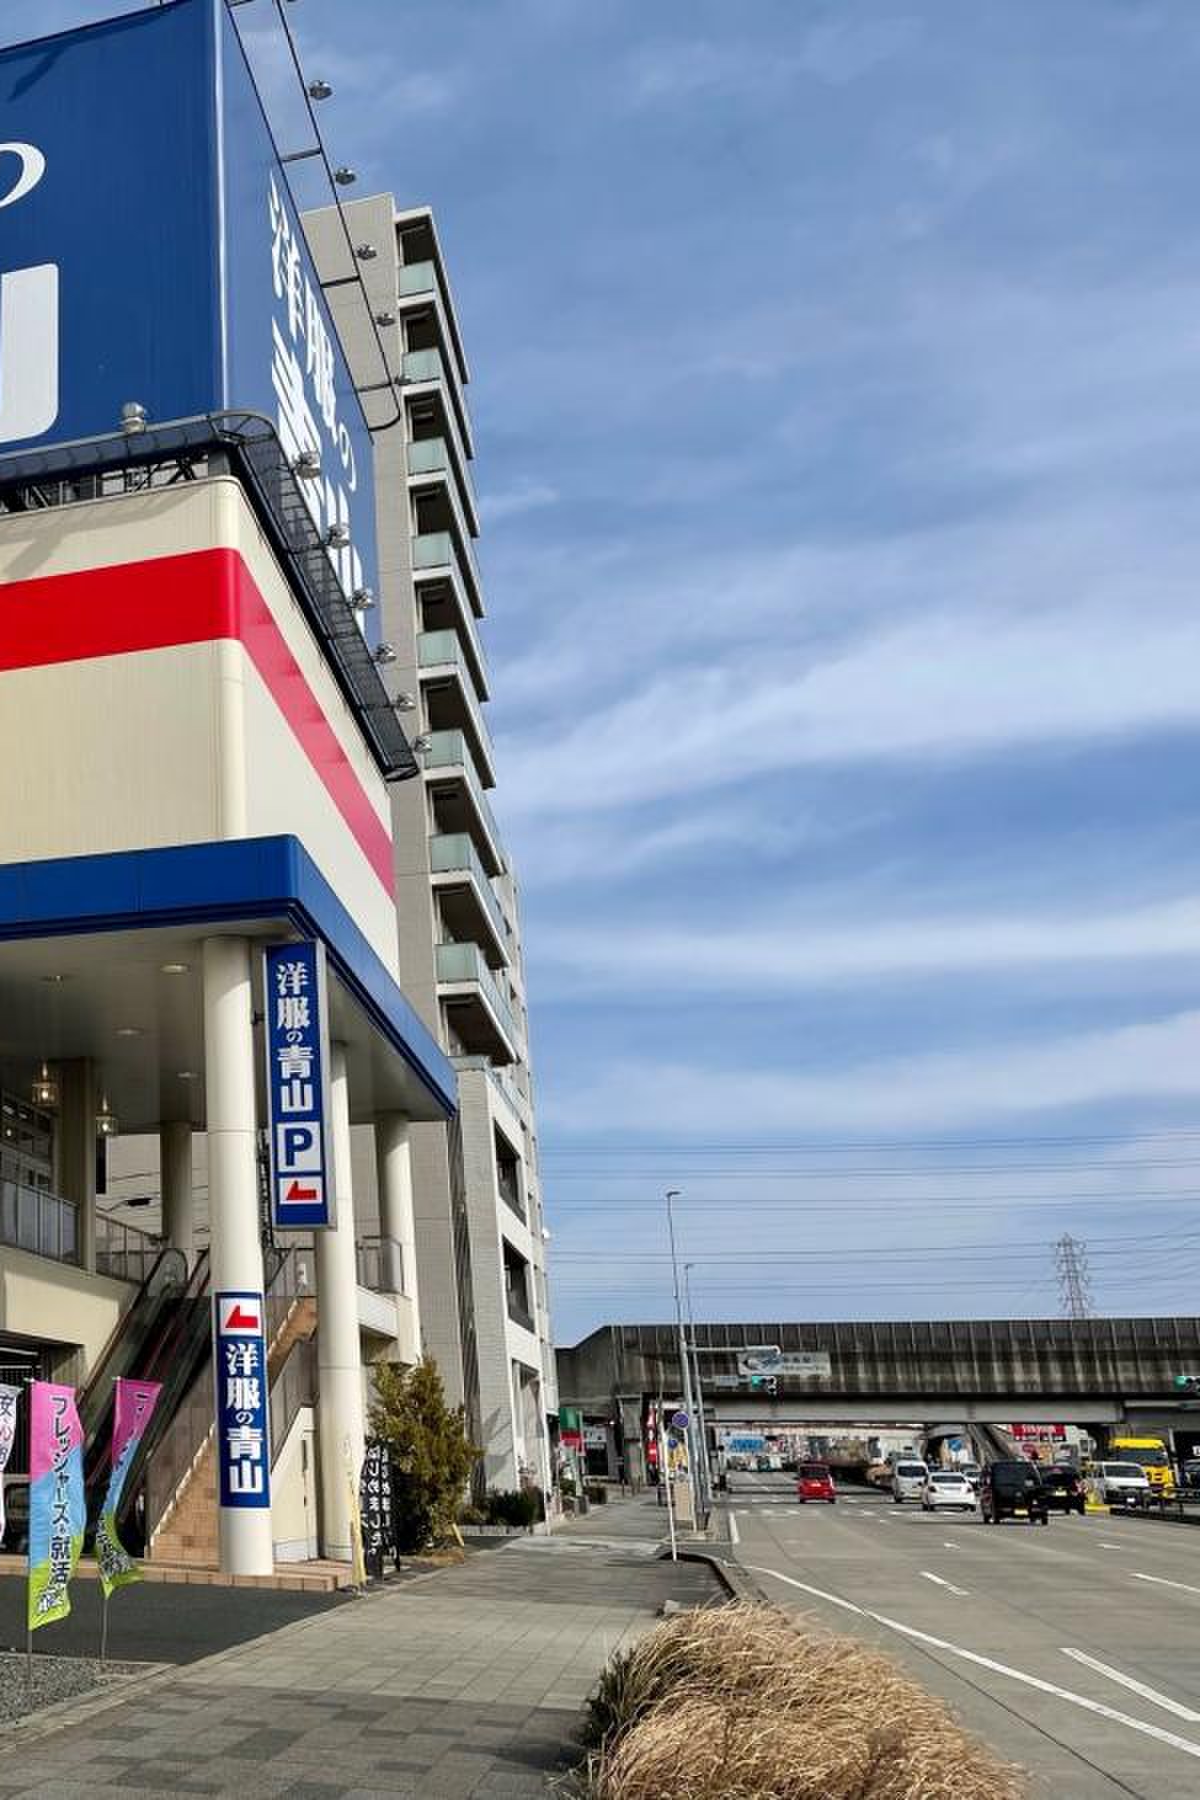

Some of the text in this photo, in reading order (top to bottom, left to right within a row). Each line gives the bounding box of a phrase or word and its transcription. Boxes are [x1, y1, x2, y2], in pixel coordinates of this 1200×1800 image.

[276, 961, 314, 1113] 洋服の青山
[285, 1127, 312, 1167] P
[226, 1342, 264, 1494] 洋服の青山
